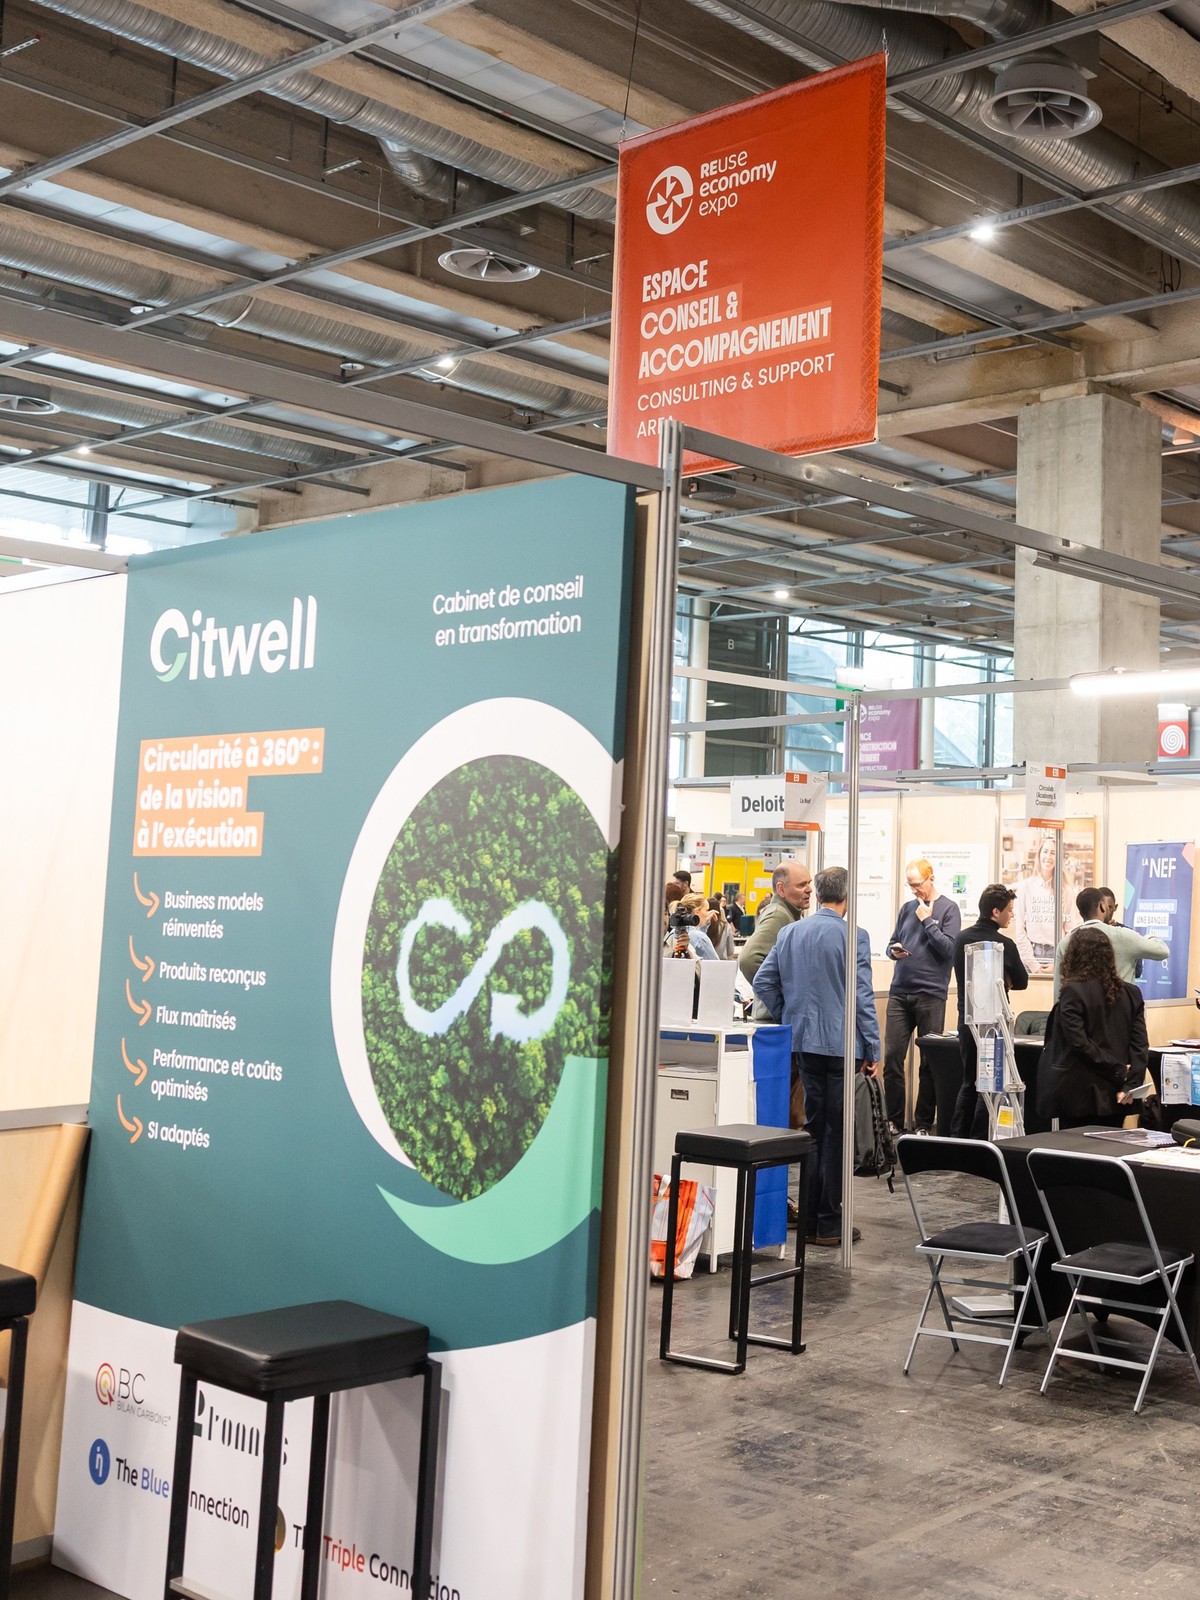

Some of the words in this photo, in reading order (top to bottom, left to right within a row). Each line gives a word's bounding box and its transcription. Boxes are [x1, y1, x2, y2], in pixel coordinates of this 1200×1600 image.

[699, 160, 777, 197] economy
[699, 192, 738, 217] expo
[642, 259, 708, 303] ESPACE
[640, 297, 721, 340] CONSEIL
[726, 290, 739, 320] &
[638, 306, 832, 380] ACCOMPAGNEMENT
[637, 375, 737, 411] CONSULTING
[742, 371, 754, 390] &
[758, 353, 835, 386] SUPPORT
[432, 588, 496, 614] Cabinet
[498, 585, 520, 607] de
[524, 575, 584, 604] conseil
[150, 595, 317, 682] Citwell
[435, 628, 455, 646] en
[458, 611, 581, 644] transformation
[727, 639, 735, 650] B
[144, 737, 242, 772] Circularité
[246, 737, 259, 767] à
[140, 784, 162, 810] de
[165, 783, 184, 809] la
[186, 778, 243, 809] vision
[742, 795, 784, 812] Deloit
[137, 820, 149, 849] à
[152, 817, 258, 849] l'exécution
[1142, 858, 1149, 866] LA
[1150, 858, 1176, 878] NEF
[164, 891, 215, 909] Business
[217, 892, 264, 911] models
[1140, 902, 1153, 911] NOUS
[1154, 902, 1175, 911] SOMMES
[162, 918, 224, 939] réinventés
[159, 961, 207, 982] Produits
[209, 966, 266, 990] reconçus
[156, 1005, 179, 1026] Flux
[180, 1009, 237, 1031] maîtrisés
[153, 1049, 229, 1075] Performance
[231, 1060, 244, 1076] et
[246, 1060, 283, 1082] coûts
[151, 1078, 208, 1102] optimisés
[148, 1121, 158, 1139] SI
[160, 1123, 210, 1150] adaptés
[118, 1368, 145, 1404] BC
[117, 1401, 135, 1415] BILAN
[116, 1458, 138, 1487] The
[141, 1467, 170, 1498] Blue
[190, 1490, 249, 1529] nnection
[323, 1535, 365, 1573] Triple
[369, 1553, 461, 1600] Conntion
